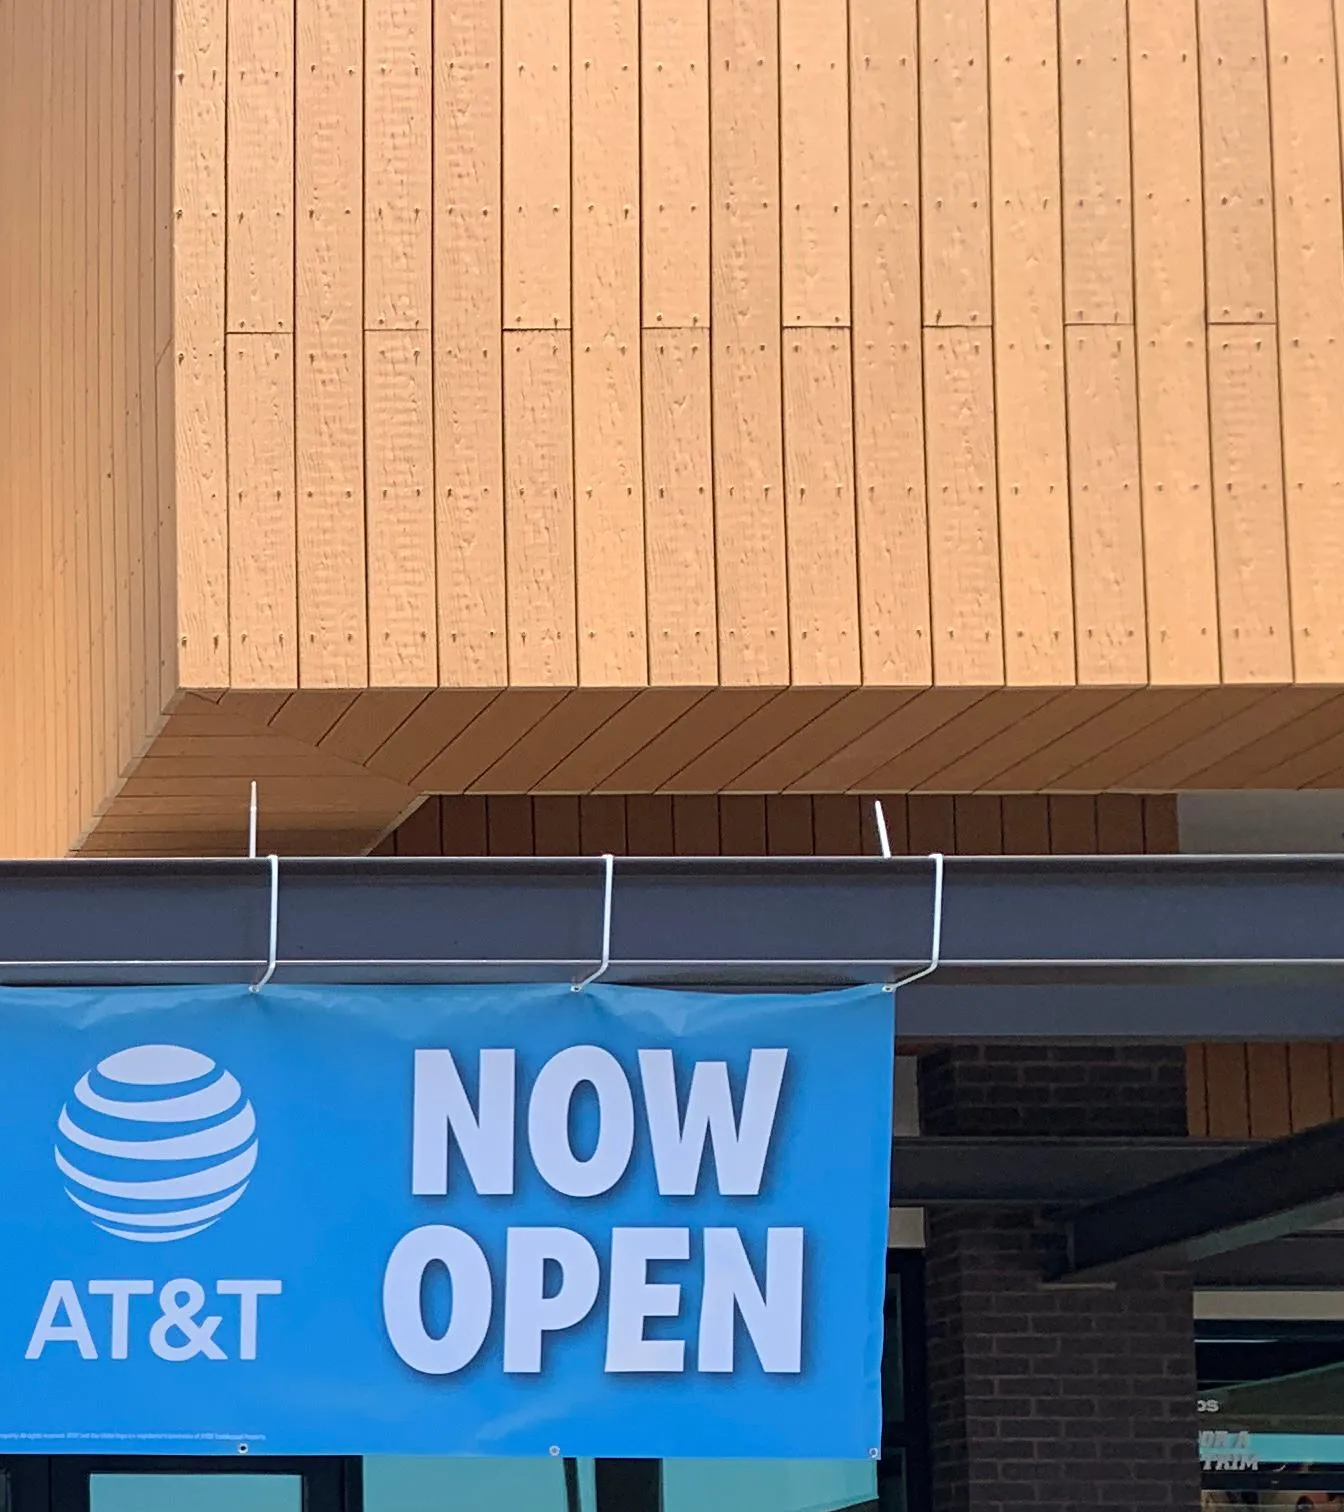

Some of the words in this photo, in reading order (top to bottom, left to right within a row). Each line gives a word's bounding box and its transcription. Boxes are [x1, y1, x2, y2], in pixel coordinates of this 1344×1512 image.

[410, 1045, 789, 1198] NOW
[25, 1278, 282, 1362] AT&T
[382, 1223, 804, 1375] OPEN
